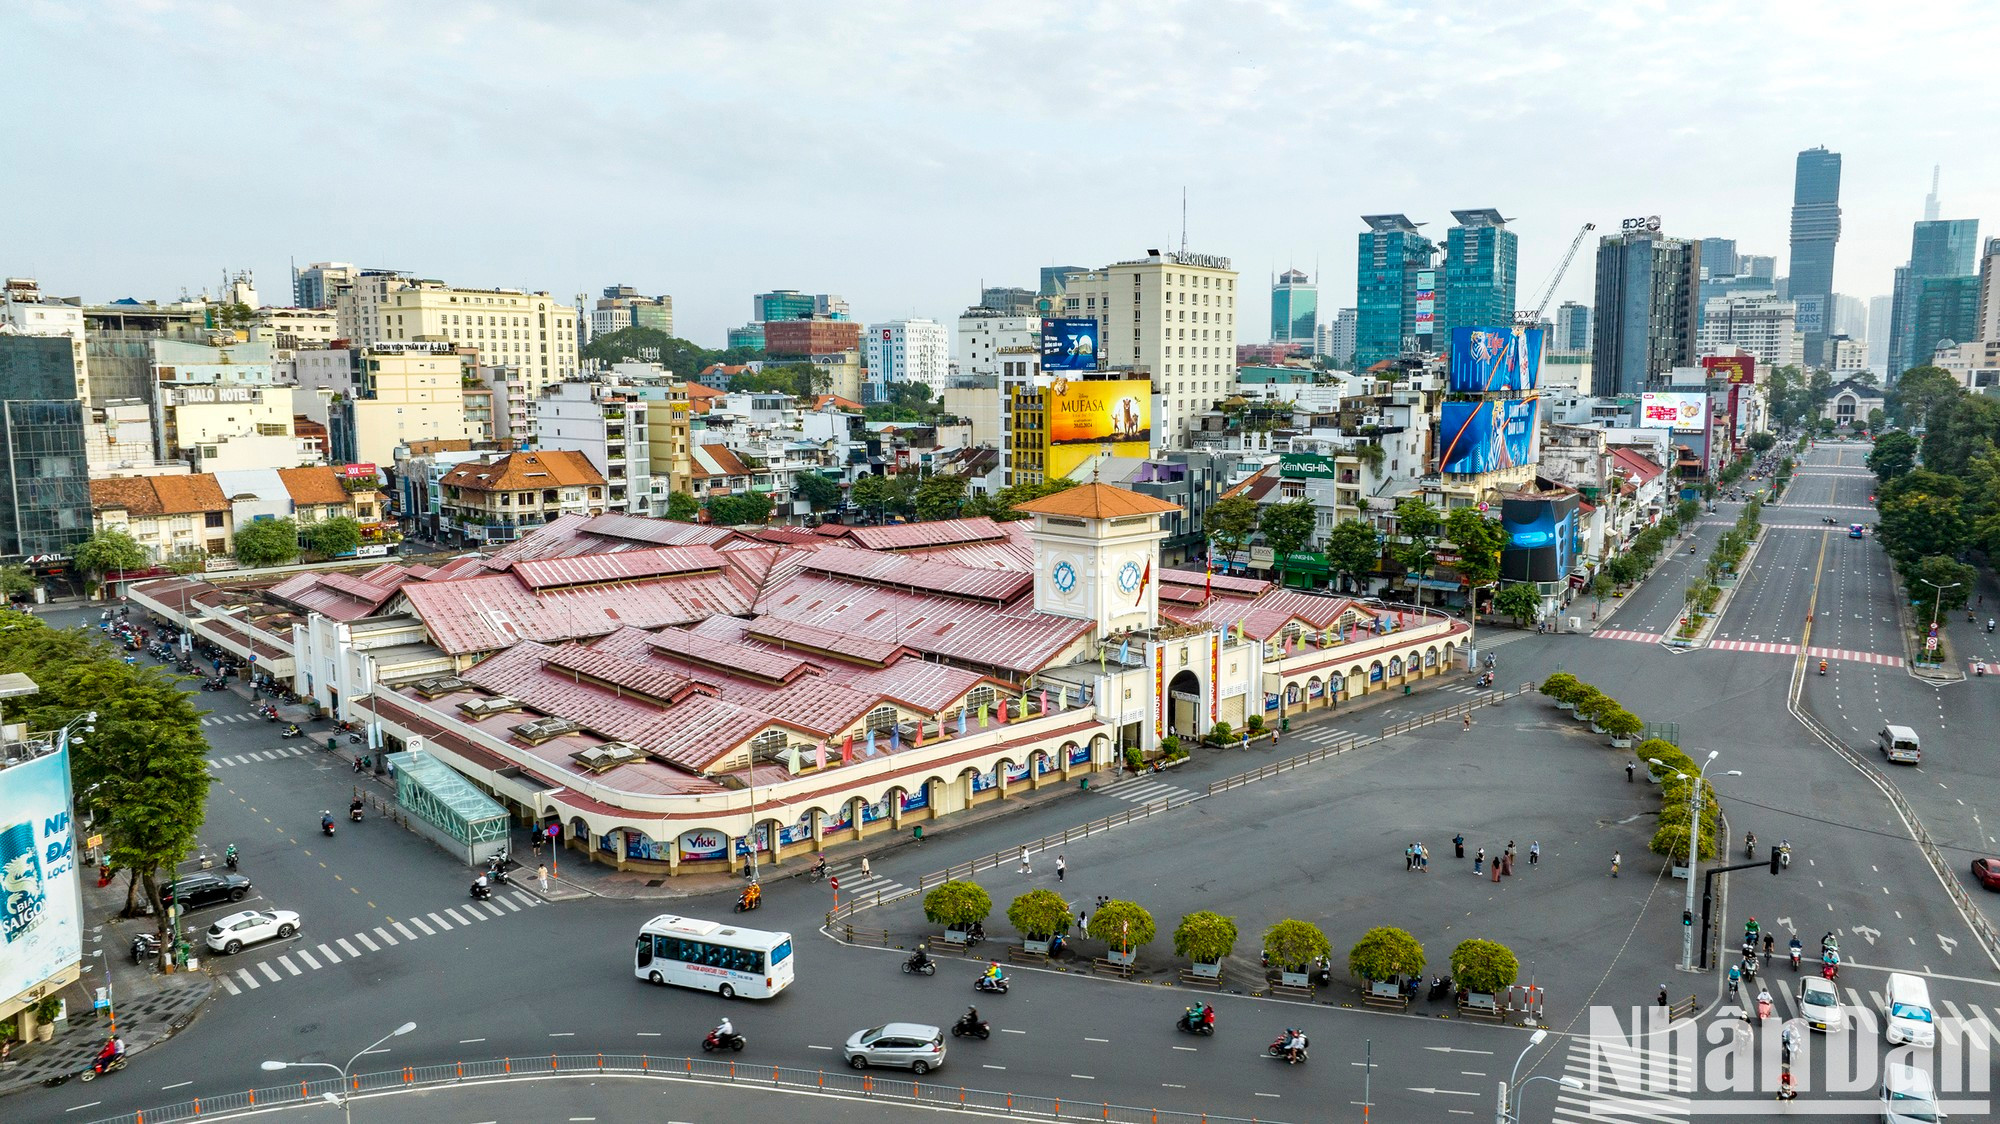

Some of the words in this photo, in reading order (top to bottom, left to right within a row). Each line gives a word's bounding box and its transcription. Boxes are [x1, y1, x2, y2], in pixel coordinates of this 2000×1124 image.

[1800, 302, 1816, 312] FOR
[1486, 332, 1504, 355] Tiger
[187, 388, 216, 402] HALO
[219, 388, 251, 402] HOTEL
[1061, 399, 1105, 412] MUFASA
[1007, 762, 1025, 773] Vikki
[688, 832, 716, 848] Vikki
[47, 863, 66, 880] LỌC
[16, 897, 34, 913] BIA
[2, 899, 47, 934] SAIGON
